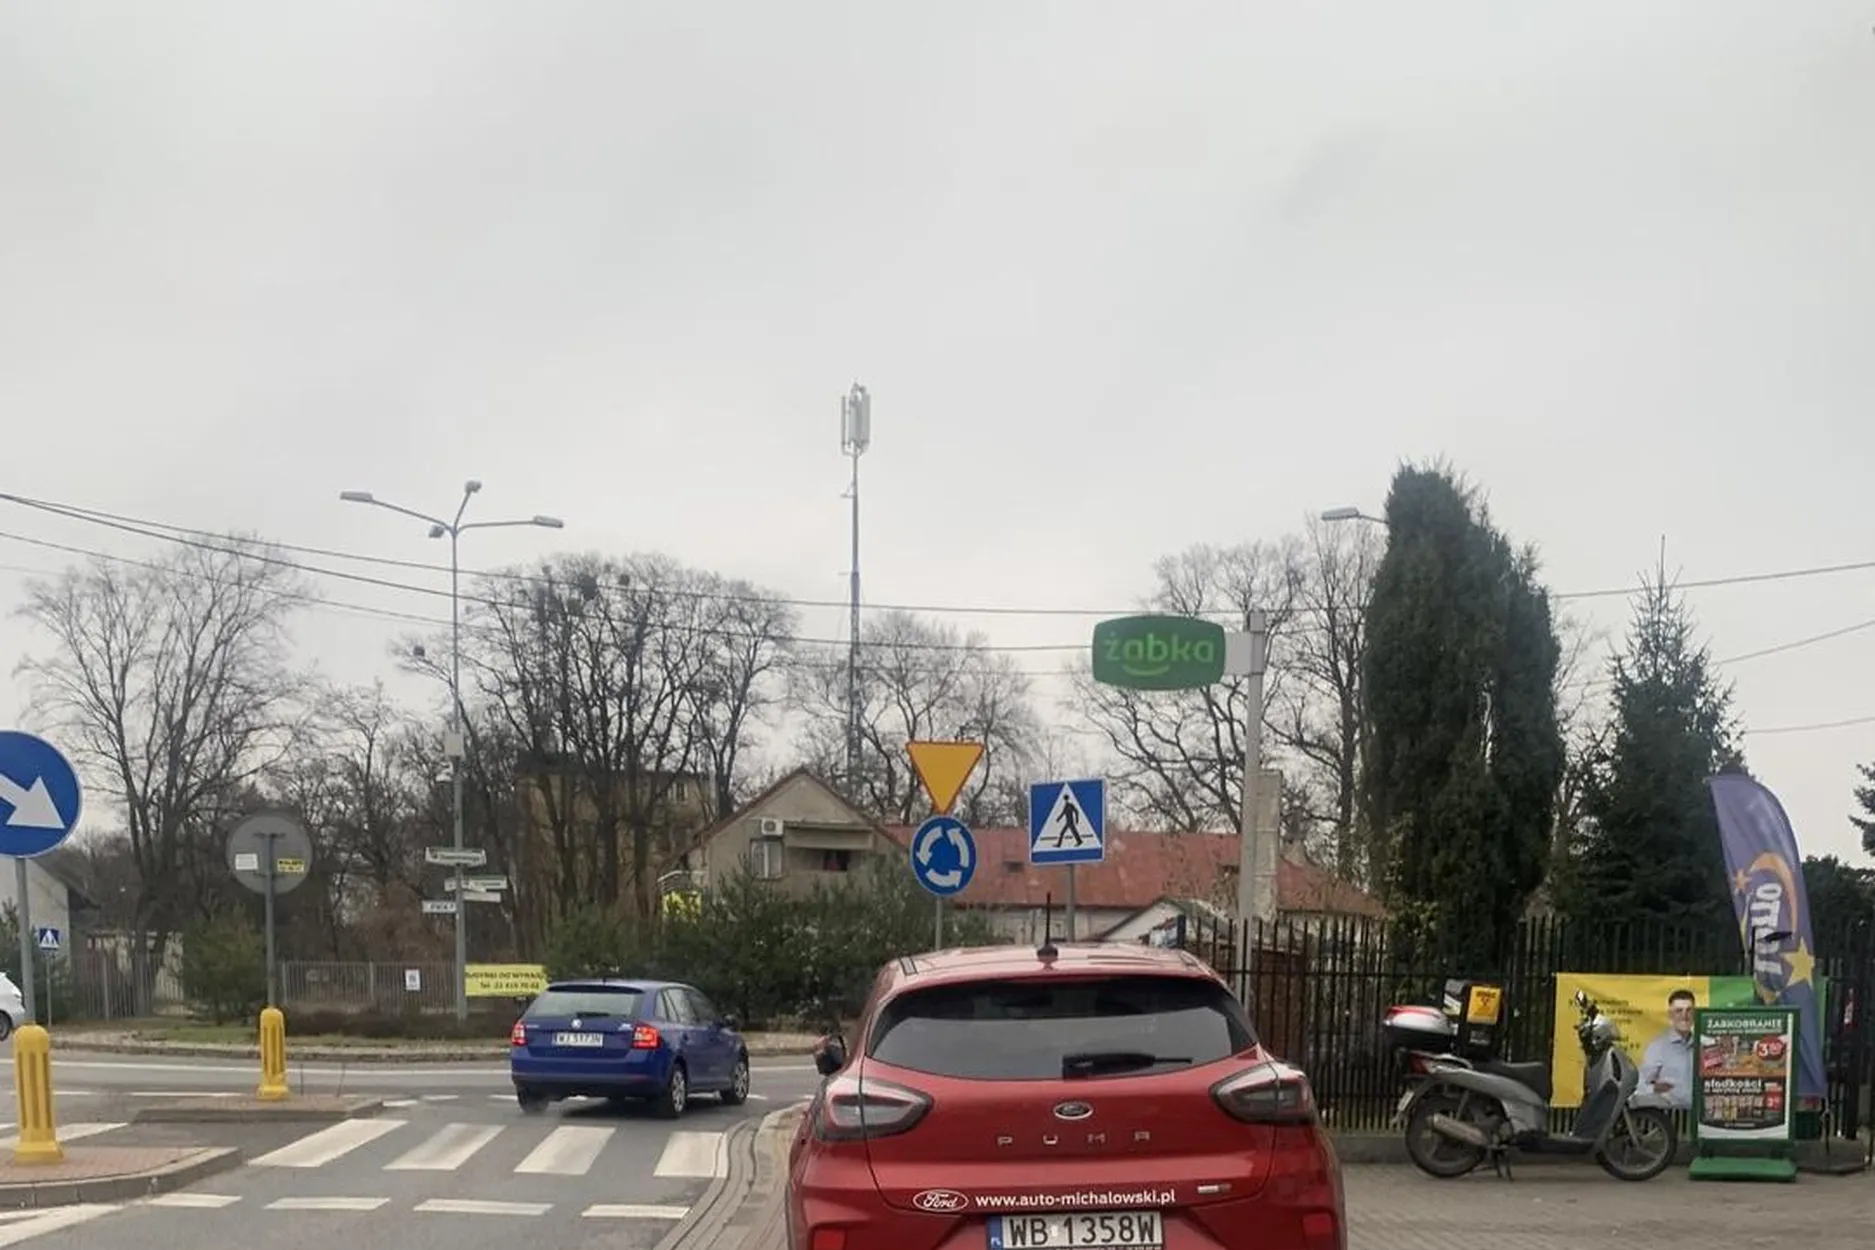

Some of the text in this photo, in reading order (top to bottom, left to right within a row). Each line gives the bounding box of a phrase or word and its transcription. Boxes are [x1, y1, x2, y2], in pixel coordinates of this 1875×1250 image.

[1103, 631, 1214, 664] żabka
[998, 1131, 1150, 1147] PUMA
[918, 1191, 962, 1210] Ford
[976, 1190, 1176, 1207] www.auto-michalowski.pl
[1009, 1217, 1049, 1246] WB
[1063, 1214, 1155, 1245] 1358W
